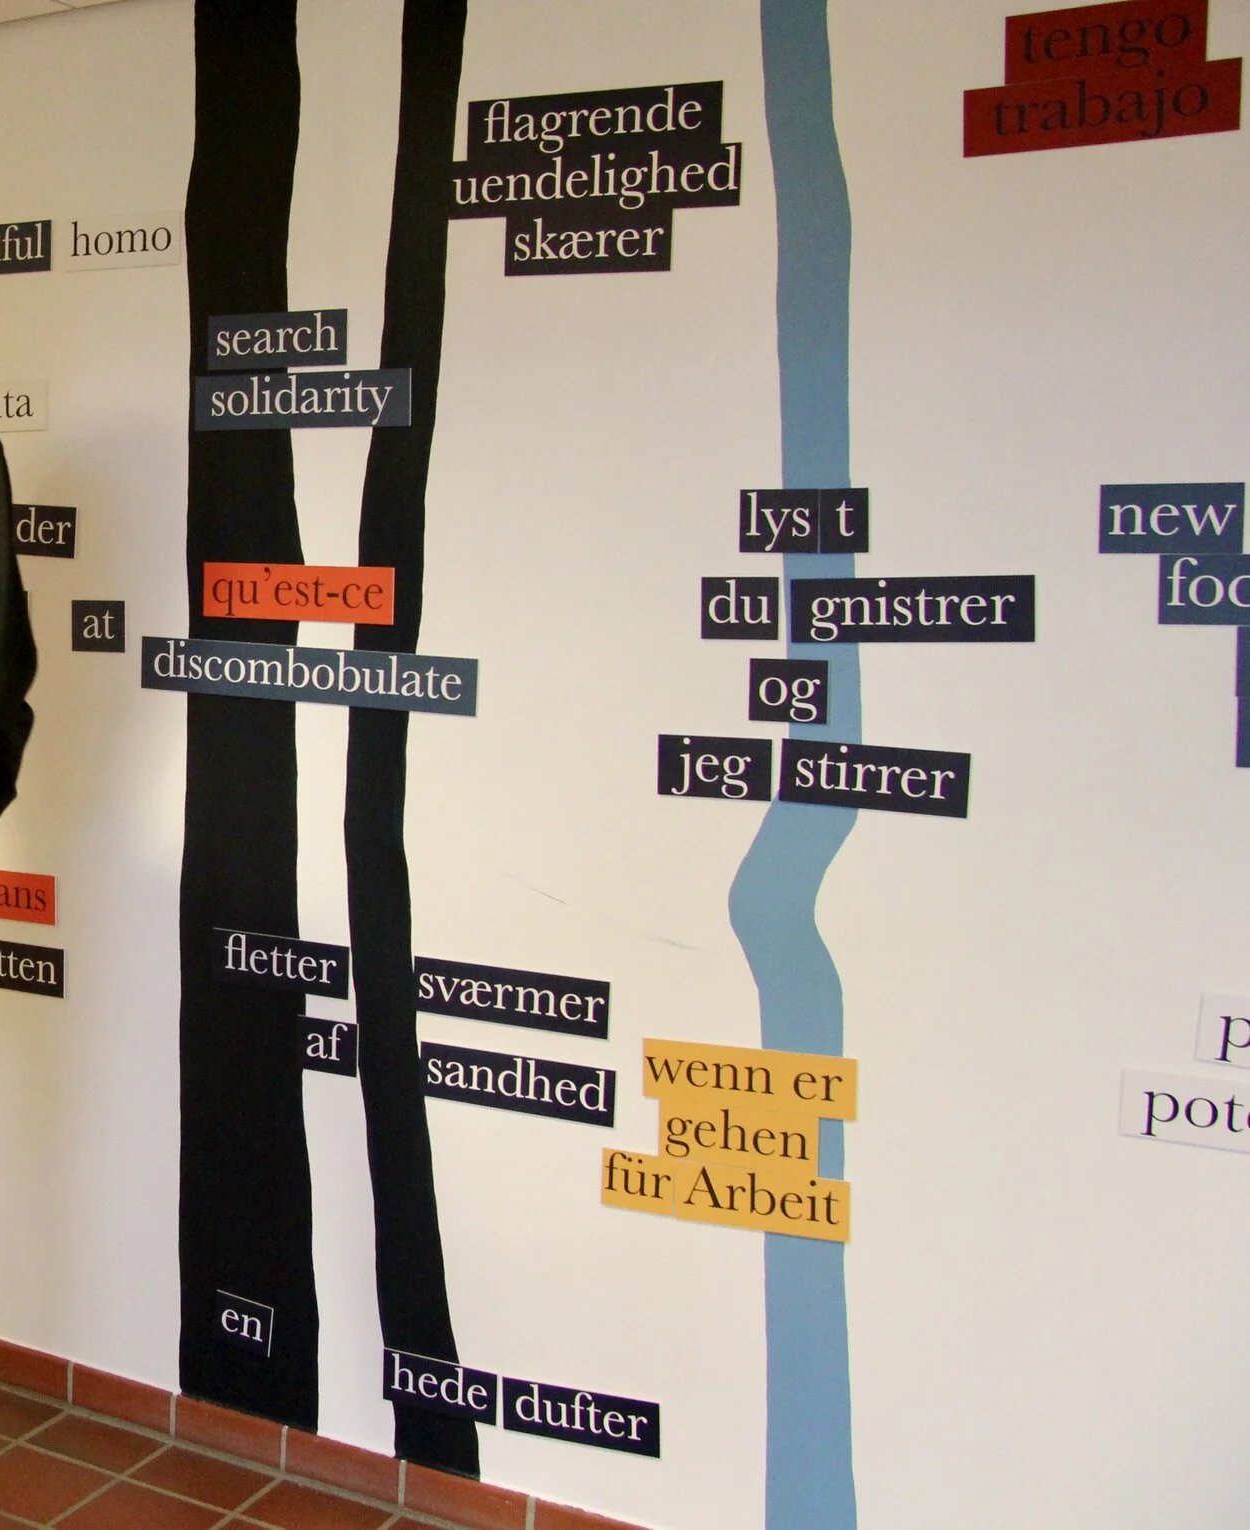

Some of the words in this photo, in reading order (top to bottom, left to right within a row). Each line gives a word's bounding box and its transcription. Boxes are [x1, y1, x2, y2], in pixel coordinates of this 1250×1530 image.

[1023, 13, 1191, 68] tengo
[484, 87, 702, 153] flagrende
[992, 69, 1210, 137] trabajo
[453, 145, 739, 209] uendelighed
[71, 221, 172, 257] homo
[514, 217, 664, 262] skærer
[216, 312, 339, 357] search
[211, 372, 393, 425] solidarity
[16, 507, 71, 545] der
[1108, 503, 1237, 536] new
[82, 610, 115, 640] at
[708, 579, 772, 624] du
[810, 579, 1015, 642] gnistrer
[154, 640, 462, 701] discombobulate
[758, 676, 821, 722] og
[671, 737, 752, 798] jeg
[795, 745, 955, 800] stirrer
[224, 933, 337, 984] fletter
[418, 972, 605, 1023] sværmer
[306, 1023, 348, 1061] af
[427, 1057, 608, 1112] sandhed
[645, 1055, 774, 1095] wenn
[793, 1071, 843, 1102] er
[665, 1109, 809, 1161] gehen
[1140, 1091, 1250, 1137] pot
[604, 1152, 671, 1199] für
[683, 1166, 840, 1225] Arbeit
[221, 1307, 263, 1342] en
[390, 1353, 488, 1410] hede
[515, 1384, 648, 1441] dufter
